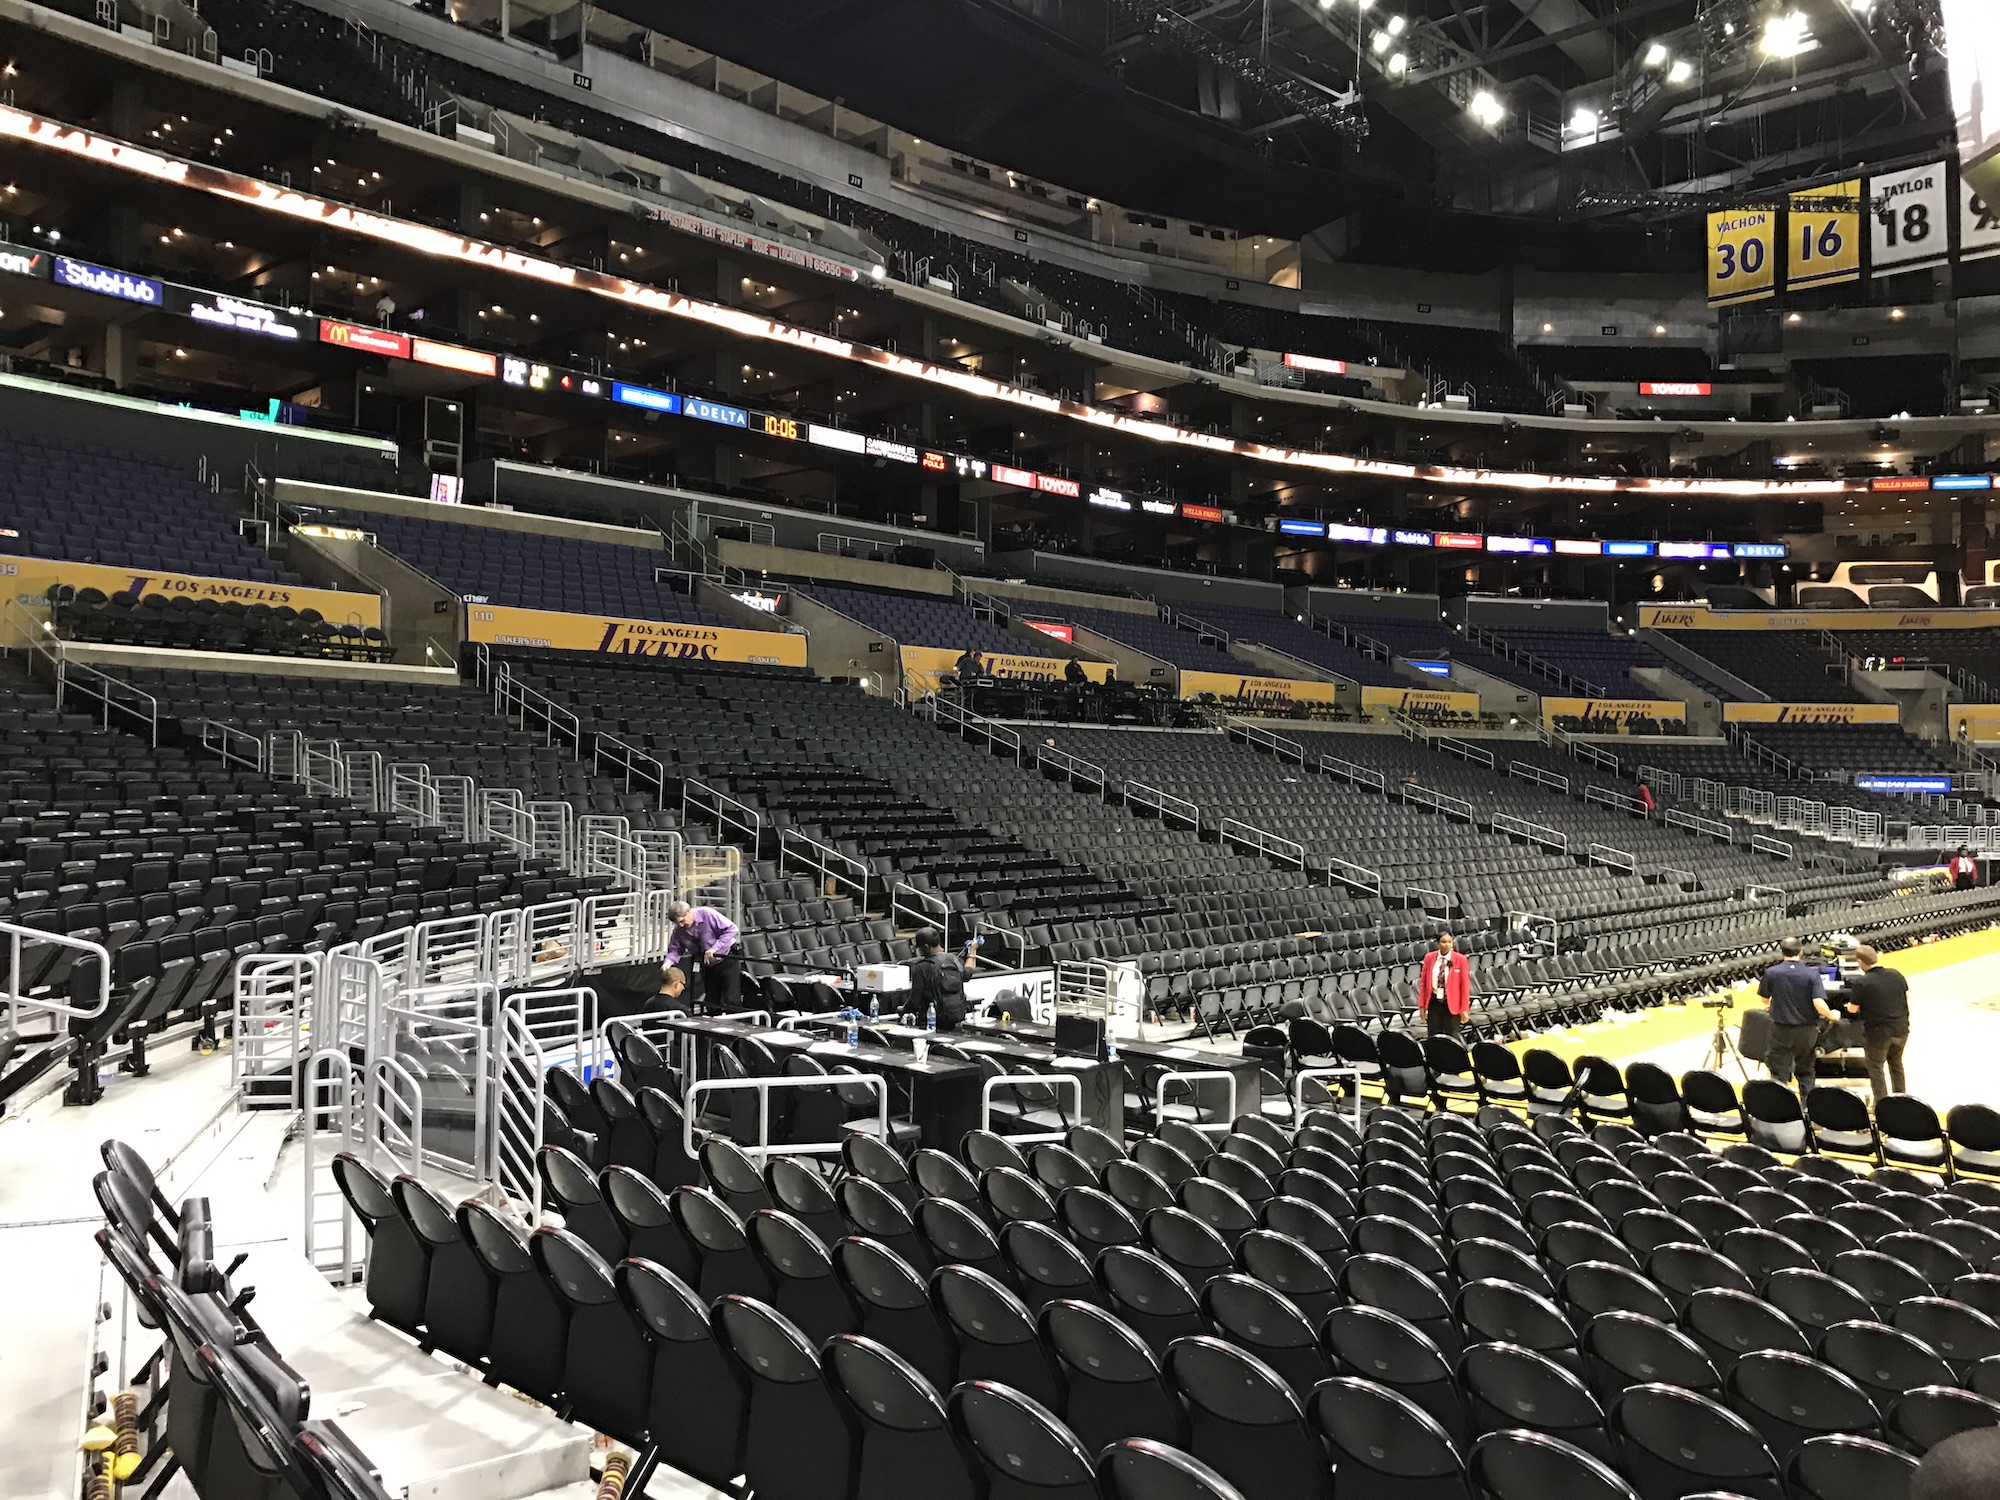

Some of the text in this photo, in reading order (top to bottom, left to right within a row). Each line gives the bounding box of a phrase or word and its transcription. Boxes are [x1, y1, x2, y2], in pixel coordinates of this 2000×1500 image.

[576, 75, 589, 87] 318
[1883, 177, 1933, 198] TAYLOR
[1717, 213, 1766, 233] VACHON
[1880, 204, 1930, 247] 18
[1802, 219, 1842, 261] 16
[701, 223, 716, 239] TEXT
[752, 239, 768, 256] ISSUE
[779, 247, 805, 266] LOCATION
[813, 259, 841, 277] 69050
[1716, 238, 1764, 279] 30
[65, 262, 155, 301] StubHub
[1650, 383, 1700, 394] TOYOTA
[700, 406, 746, 425] DELTA
[765, 416, 798, 440] 10:06
[922, 459, 946, 471] FOULS
[925, 452, 944, 463] TEAM
[1038, 475, 1080, 498] TOYOTA
[1141, 499, 1175, 514] verizon
[1183, 506, 1222, 521] WELLS FARGO
[1395, 531, 1429, 546] StubHub
[1747, 546, 1784, 555] DELTA
[162, 579, 200, 593] LOS
[202, 584, 292, 603] ANGELES
[473, 611, 494, 622] 110
[1652, 610, 1696, 627] LAKERS
[495, 635, 551, 647] LAKERS.COM
[628, 624, 718, 641] LOS ANGELES
[1000, 658, 1057, 670] LOS ANGELES
[1264, 681, 1291, 689] ANGELES
